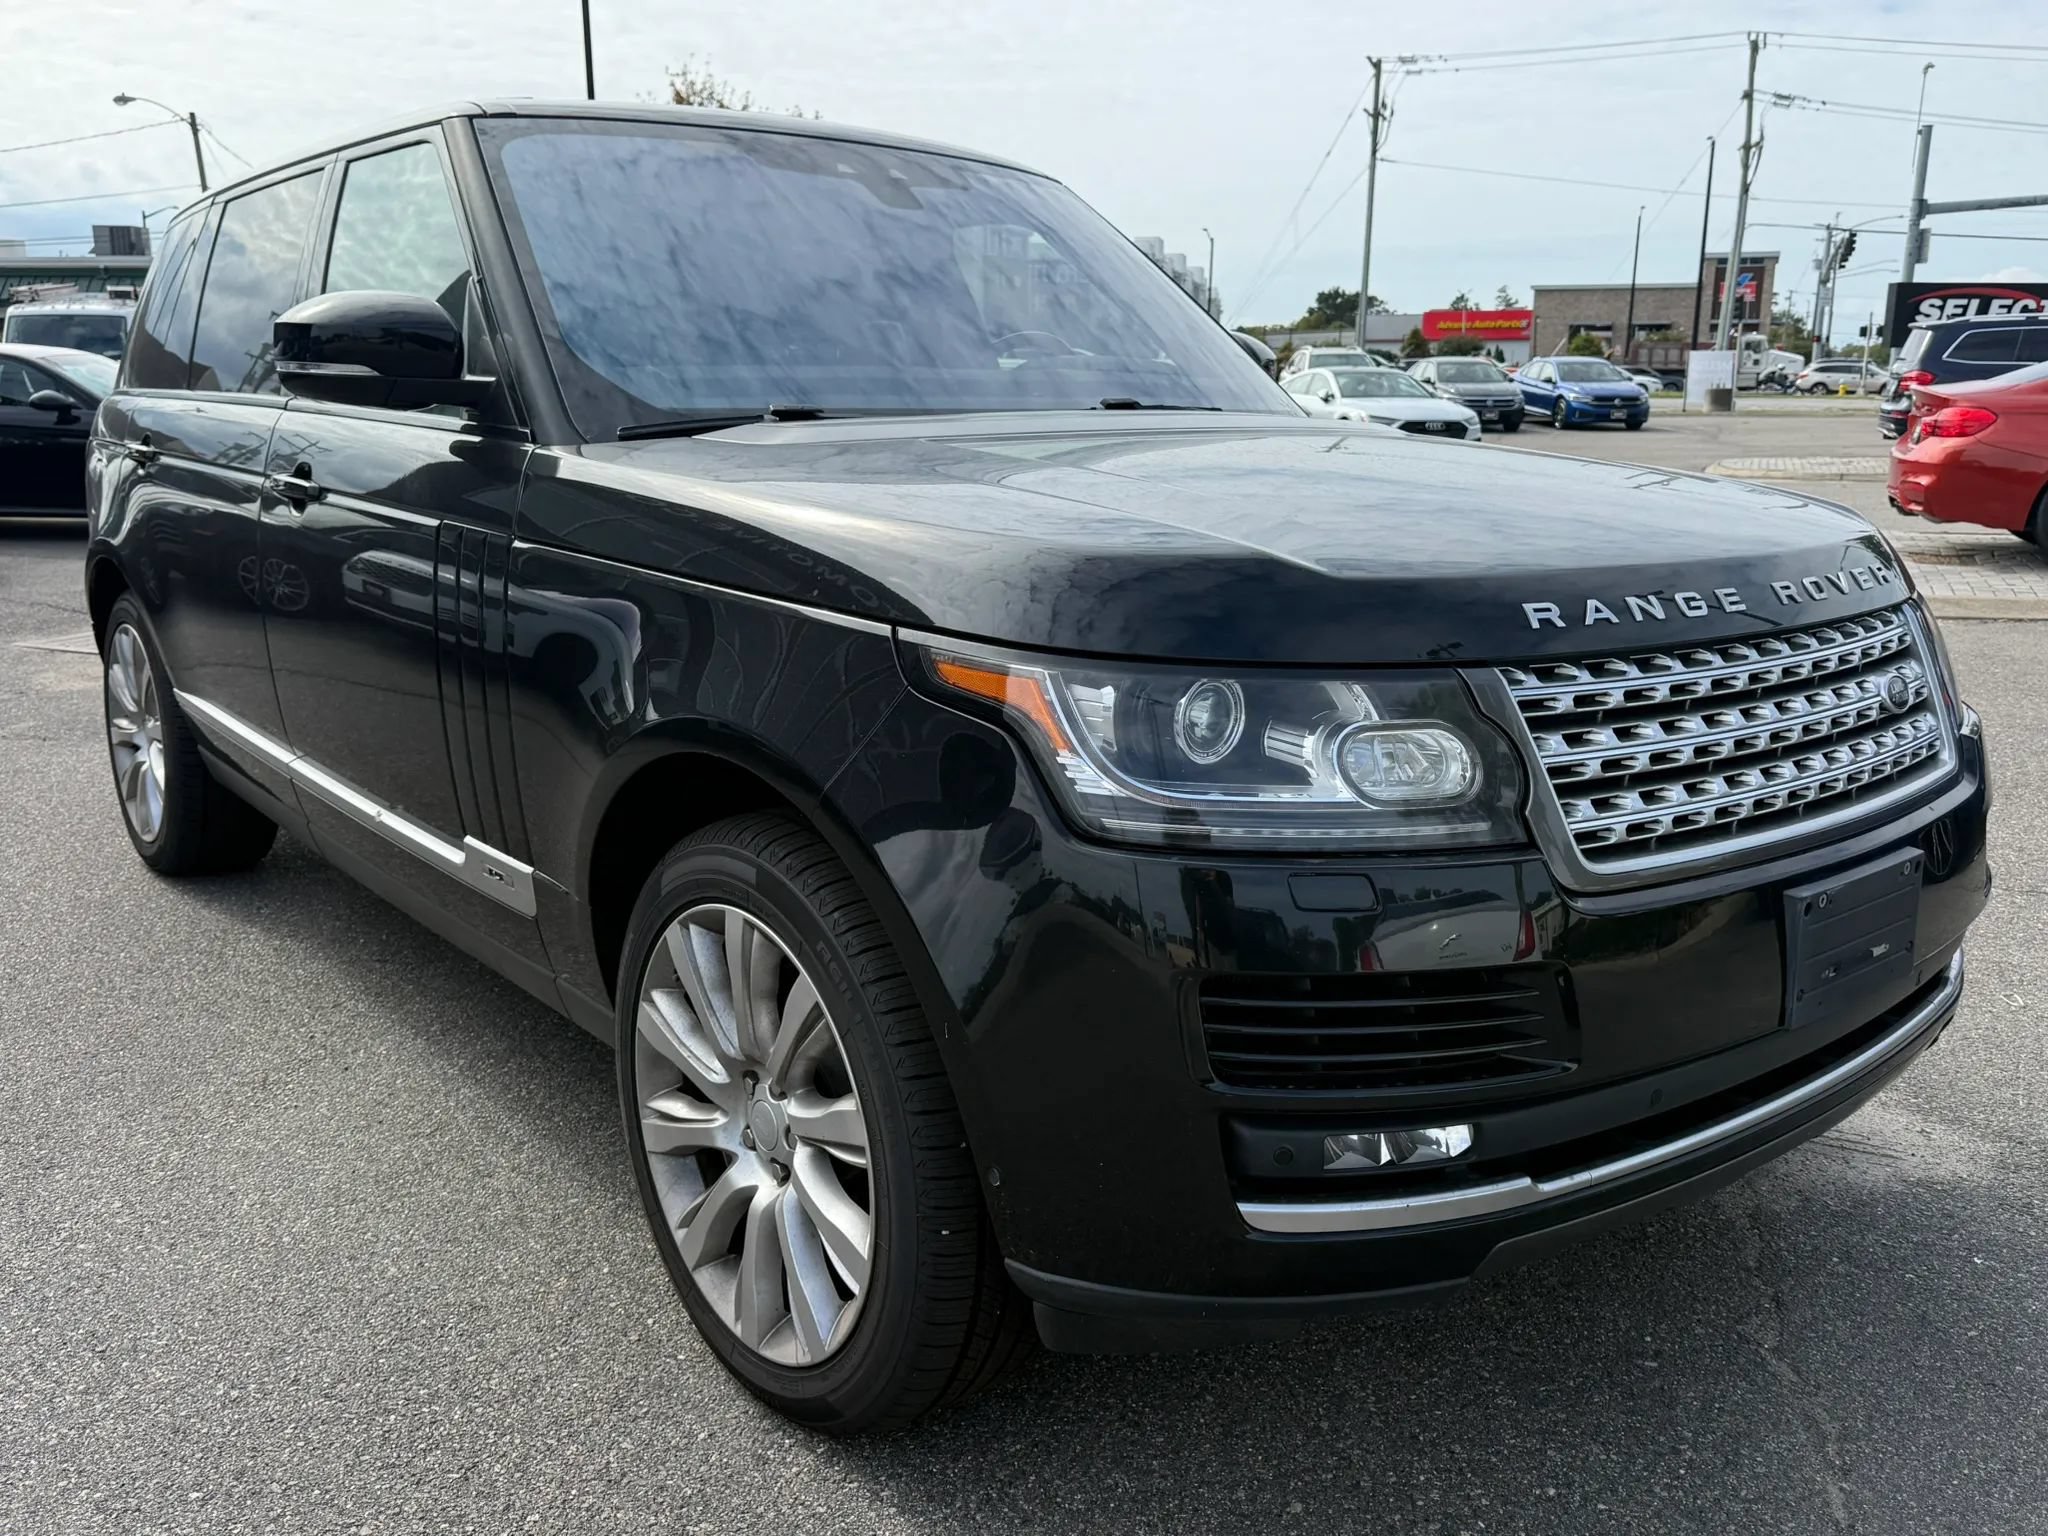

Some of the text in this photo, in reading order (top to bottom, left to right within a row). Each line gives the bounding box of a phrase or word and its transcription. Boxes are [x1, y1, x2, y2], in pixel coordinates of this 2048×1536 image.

[1914, 298, 2048, 323] SELEC
[1521, 563, 1892, 630] RANGE ROVER
